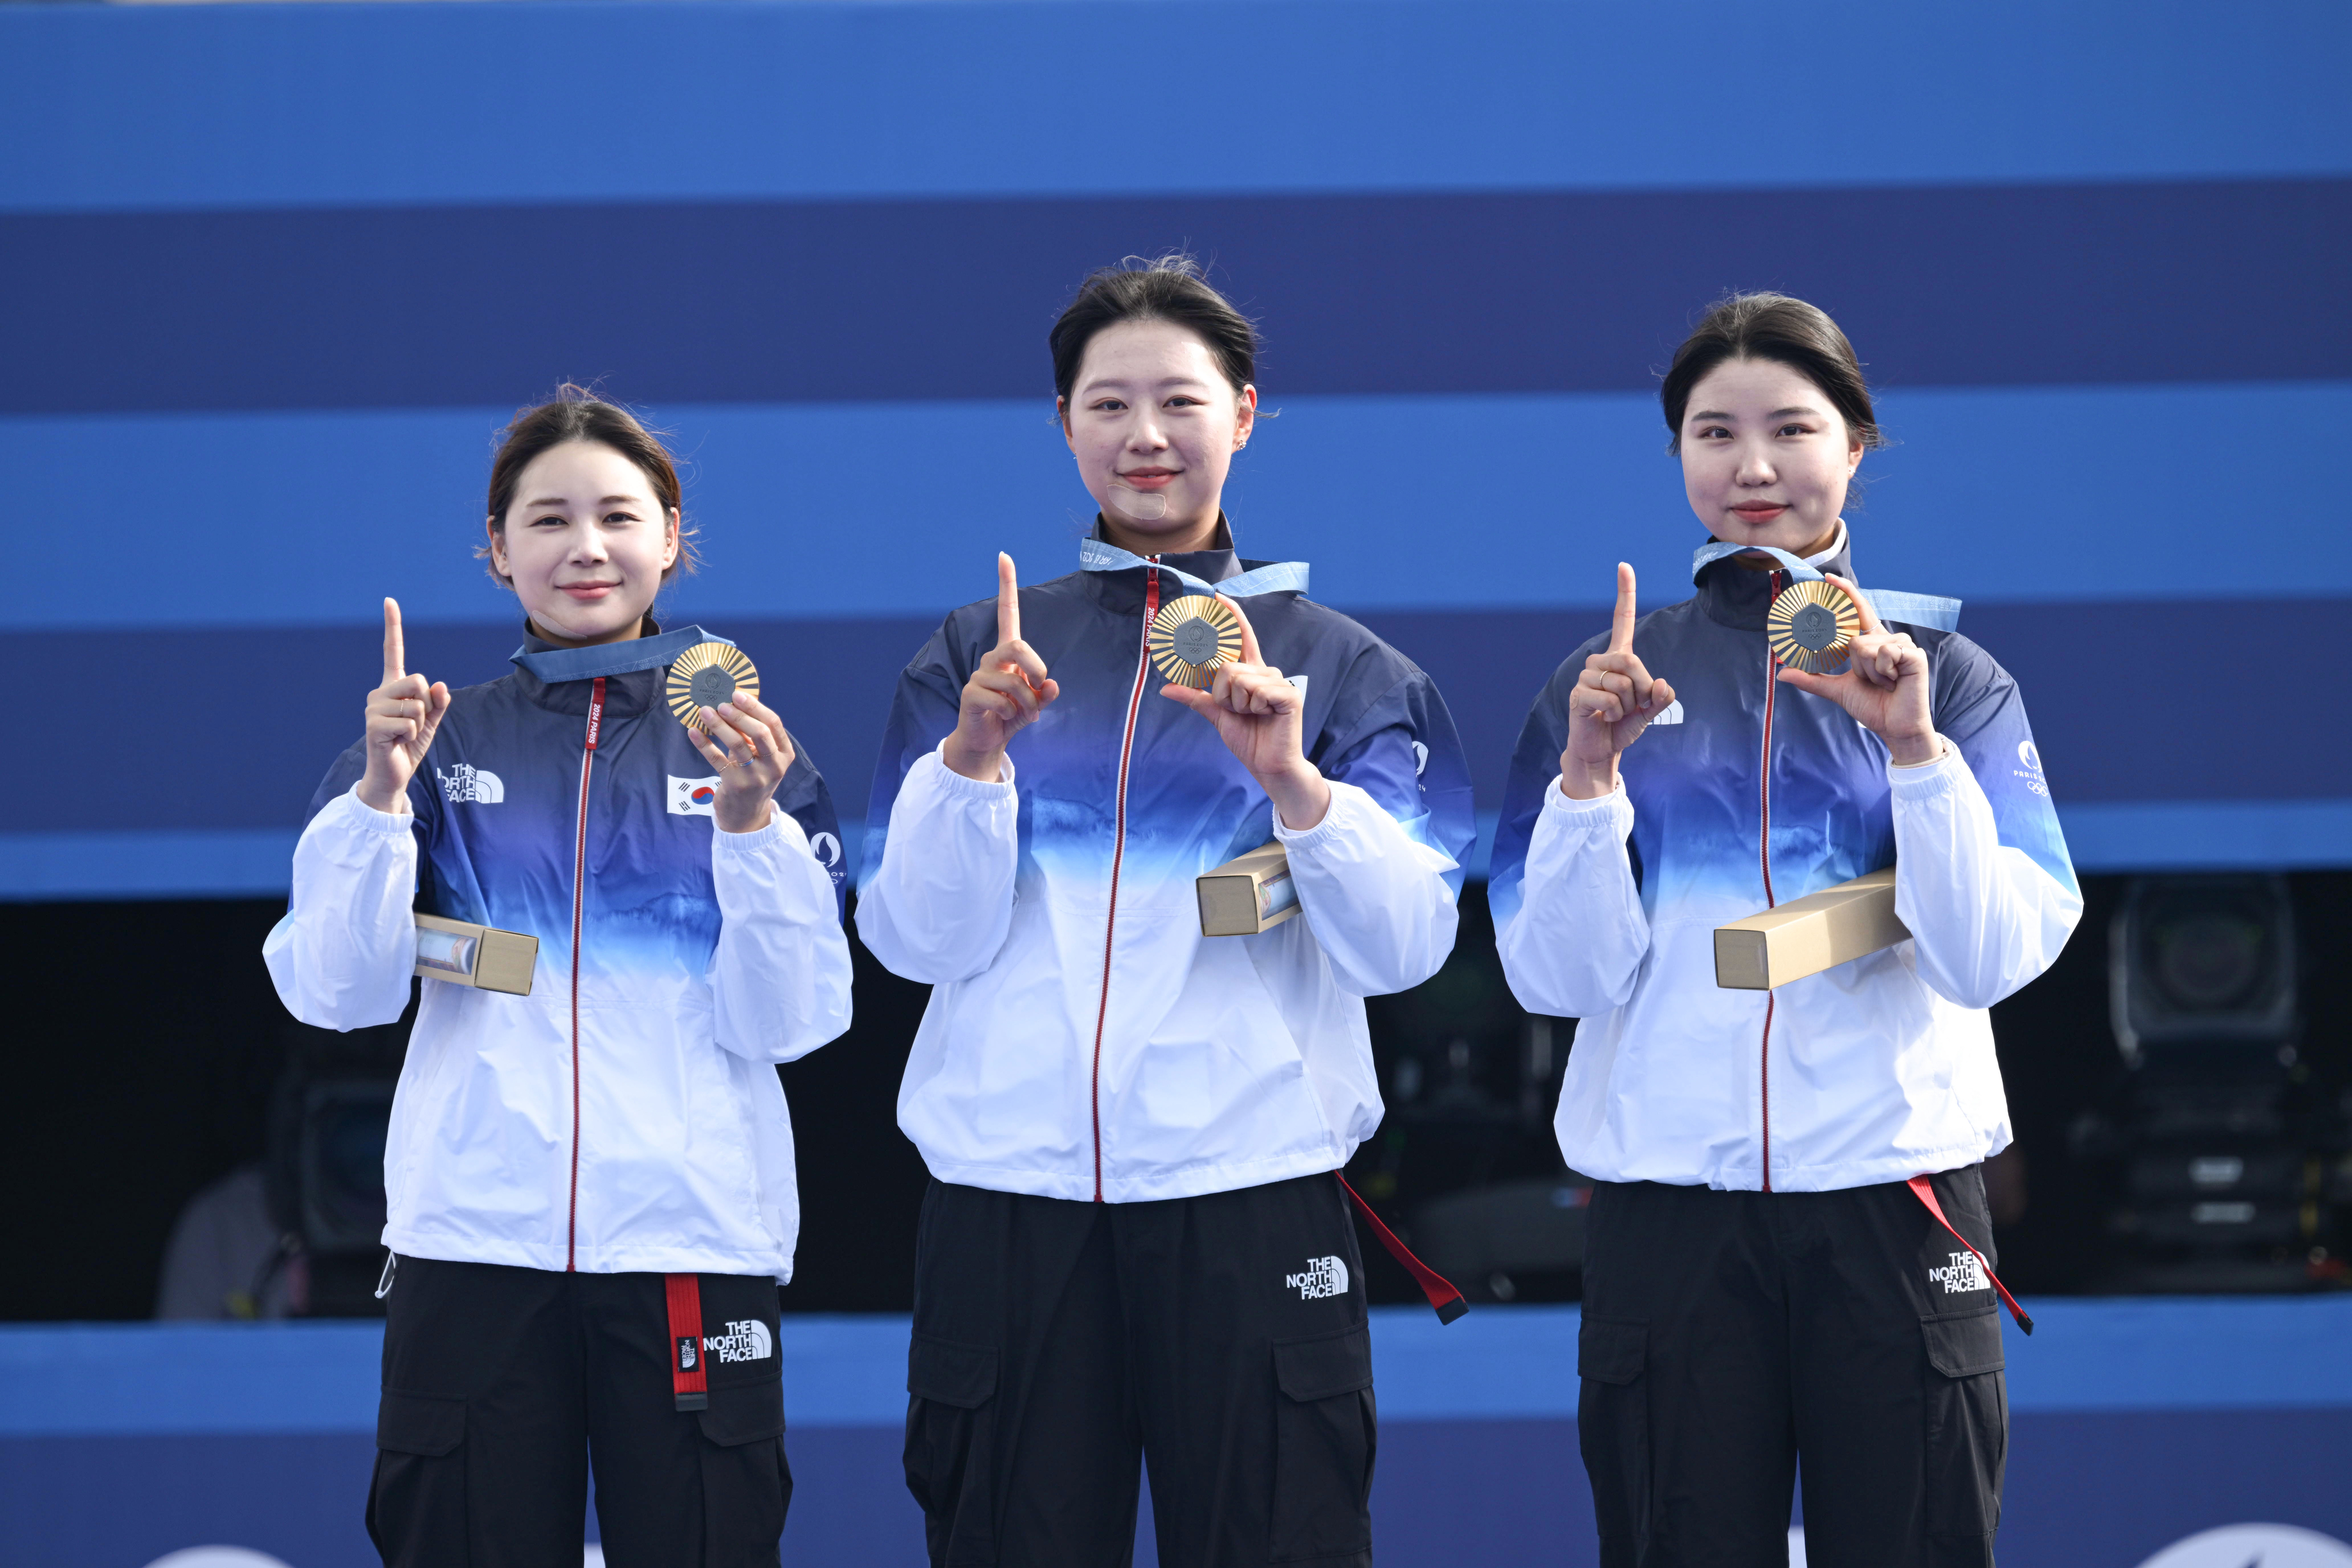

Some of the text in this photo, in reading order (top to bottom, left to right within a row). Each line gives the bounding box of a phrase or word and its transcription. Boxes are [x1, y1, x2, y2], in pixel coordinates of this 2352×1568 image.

[588, 703, 600, 744] 2024 PARIS
[452, 763, 476, 780] THE
[2013, 770, 2038, 780] PARIS
[1307, 1256, 1331, 1272] THE
[1949, 1251, 1973, 1266] THE
[1286, 1270, 1332, 1288] NORTH
[1929, 1264, 1974, 1282] NORTH
[1301, 1283, 1333, 1300] FACE
[1945, 1278, 1975, 1293] FACE
[725, 1320, 751, 1335] THE
[703, 1333, 751, 1351] NORTH
[719, 1347, 752, 1363] FACE
